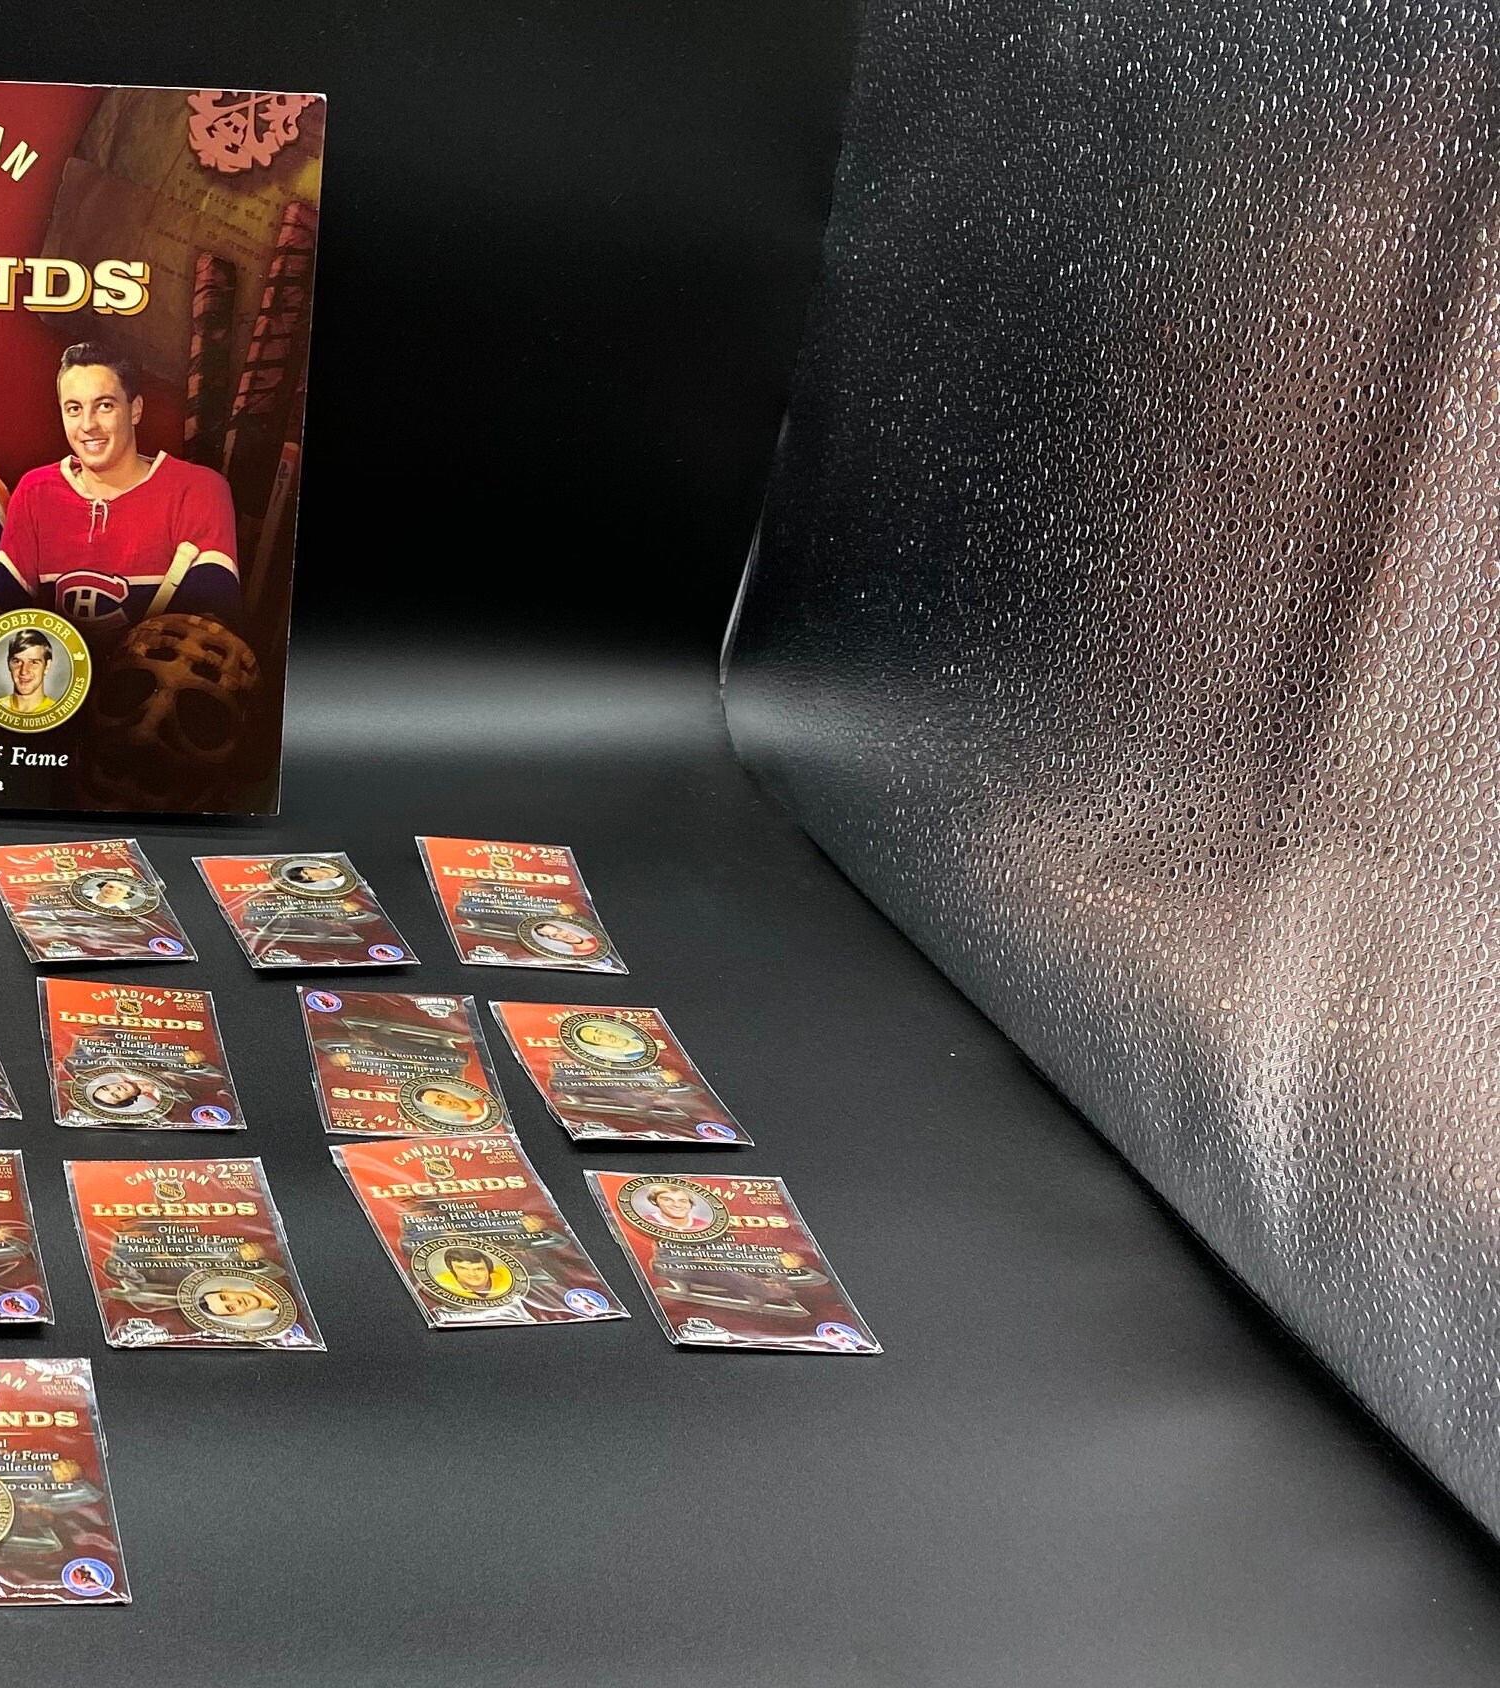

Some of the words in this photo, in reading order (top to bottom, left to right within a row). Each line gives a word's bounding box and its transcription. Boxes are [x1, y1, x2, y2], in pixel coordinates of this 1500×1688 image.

[43, 617, 72, 641] ORR
[23, 713, 57, 727] NORRIS
[59, 677, 85, 718] TROPHIES
[10, 747, 69, 767] Fame
[467, 845, 533, 862] CANADIAN
[442, 866, 571, 886] LEGENDS
[91, 989, 166, 1007] CANADIAN
[58, 1011, 205, 1031] LEGENDS
[79, 1039, 117, 1048] Hockey
[121, 1040, 145, 1048] Hall
[162, 1043, 190, 1051] Fame
[392, 1145, 474, 1167] CANADIAN
[125, 1167, 210, 1187] CANADIAN
[368, 1175, 528, 1199] LEGENDS
[92, 1202, 258, 1217] LEGENDS
[438, 1202, 478, 1212] Official
[404, 1214, 446, 1225] Hockey
[449, 1210, 476, 1222] Hall
[478, 1210, 492, 1221] of
[493, 1208, 524, 1218] Fame
[158, 1225, 200, 1235] Official
[415, 1222, 464, 1232] Medallion
[470, 1218, 522, 1228] Collection
[118, 1235, 162, 1244] Hockey
[167, 1235, 194, 1244] Hall
[197, 1235, 209, 1246] of
[212, 1235, 245, 1244] Fame
[502, 1232, 545, 1241] COLLECT
[128, 1244, 182, 1253] Medallion
[185, 1244, 240, 1253] Collection
[469, 1239, 520, 1269] DIONNE
[670, 1250, 722, 1259] Medallion
[724, 1252, 780, 1260] Collection
[706, 1242, 731, 1251] Hall
[751, 1244, 783, 1253] Fame
[2, 1451, 18, 1463] of
[22, 1452, 59, 1461] Fame
[20, 1482, 74, 1490] COLLECT
